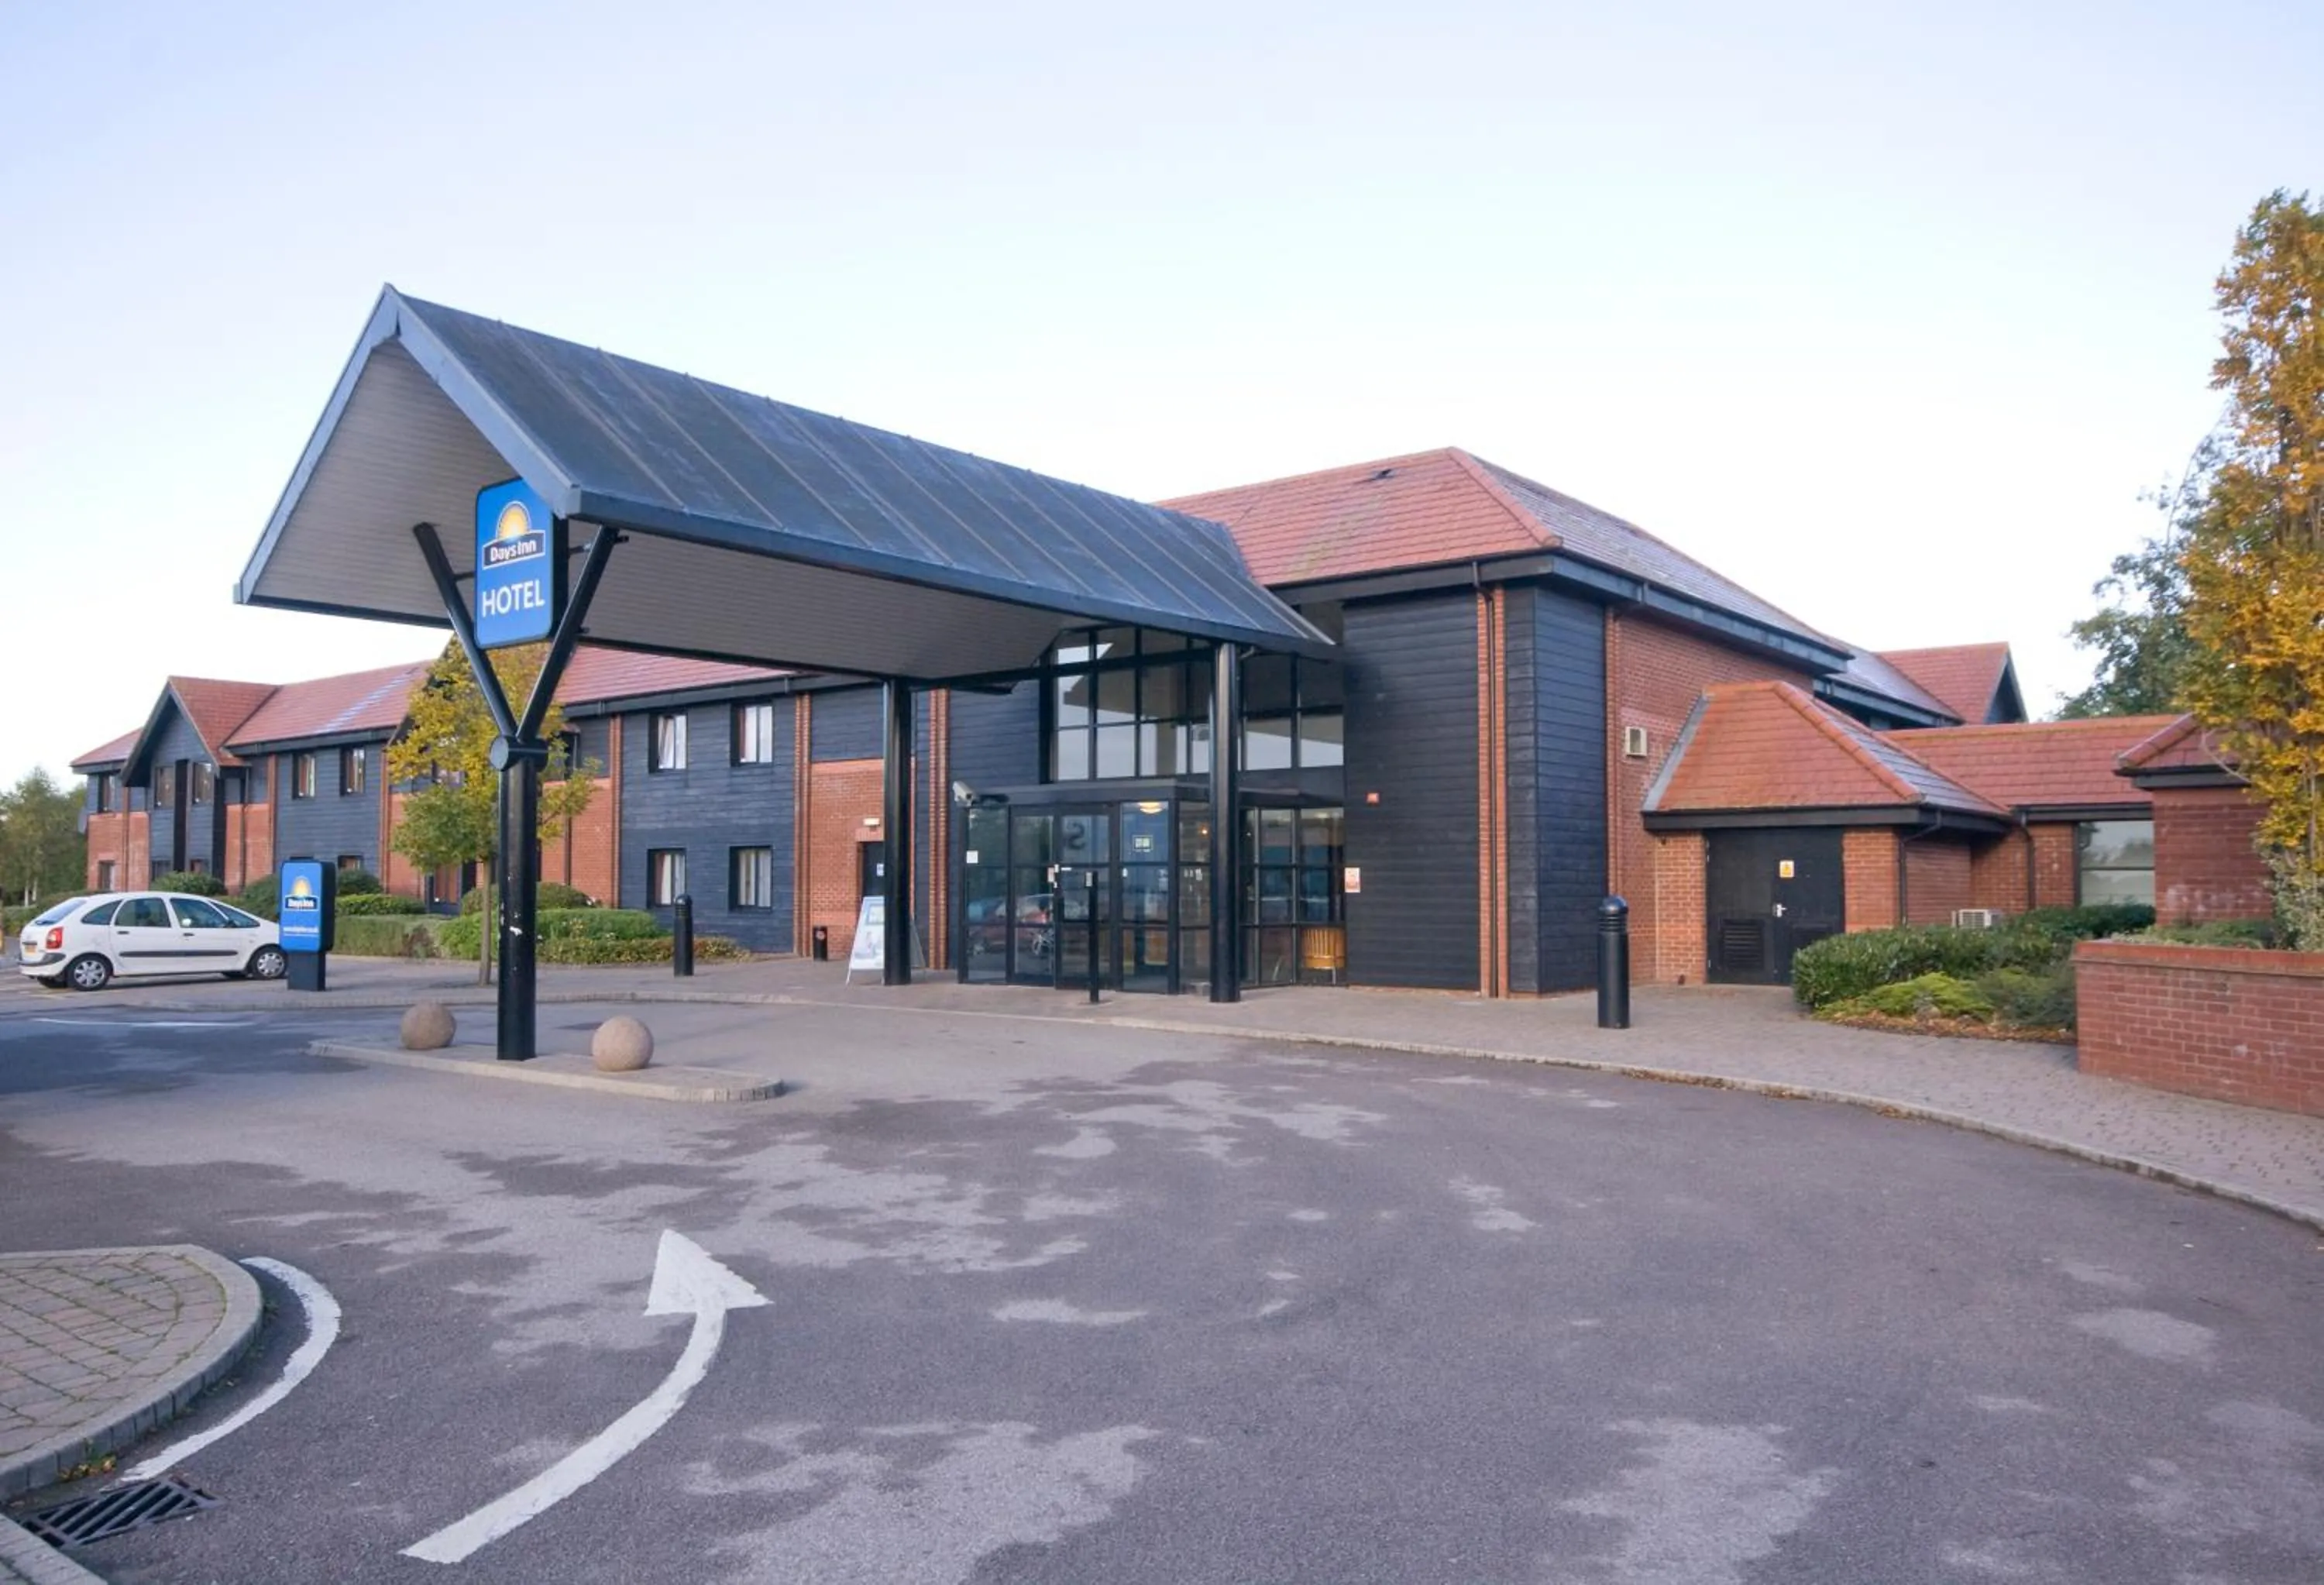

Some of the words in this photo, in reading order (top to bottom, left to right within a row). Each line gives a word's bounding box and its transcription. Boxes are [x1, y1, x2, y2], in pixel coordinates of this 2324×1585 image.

[490, 545, 517, 562] Days
[517, 539, 537, 555] Inn
[482, 579, 546, 617] HOTEL
